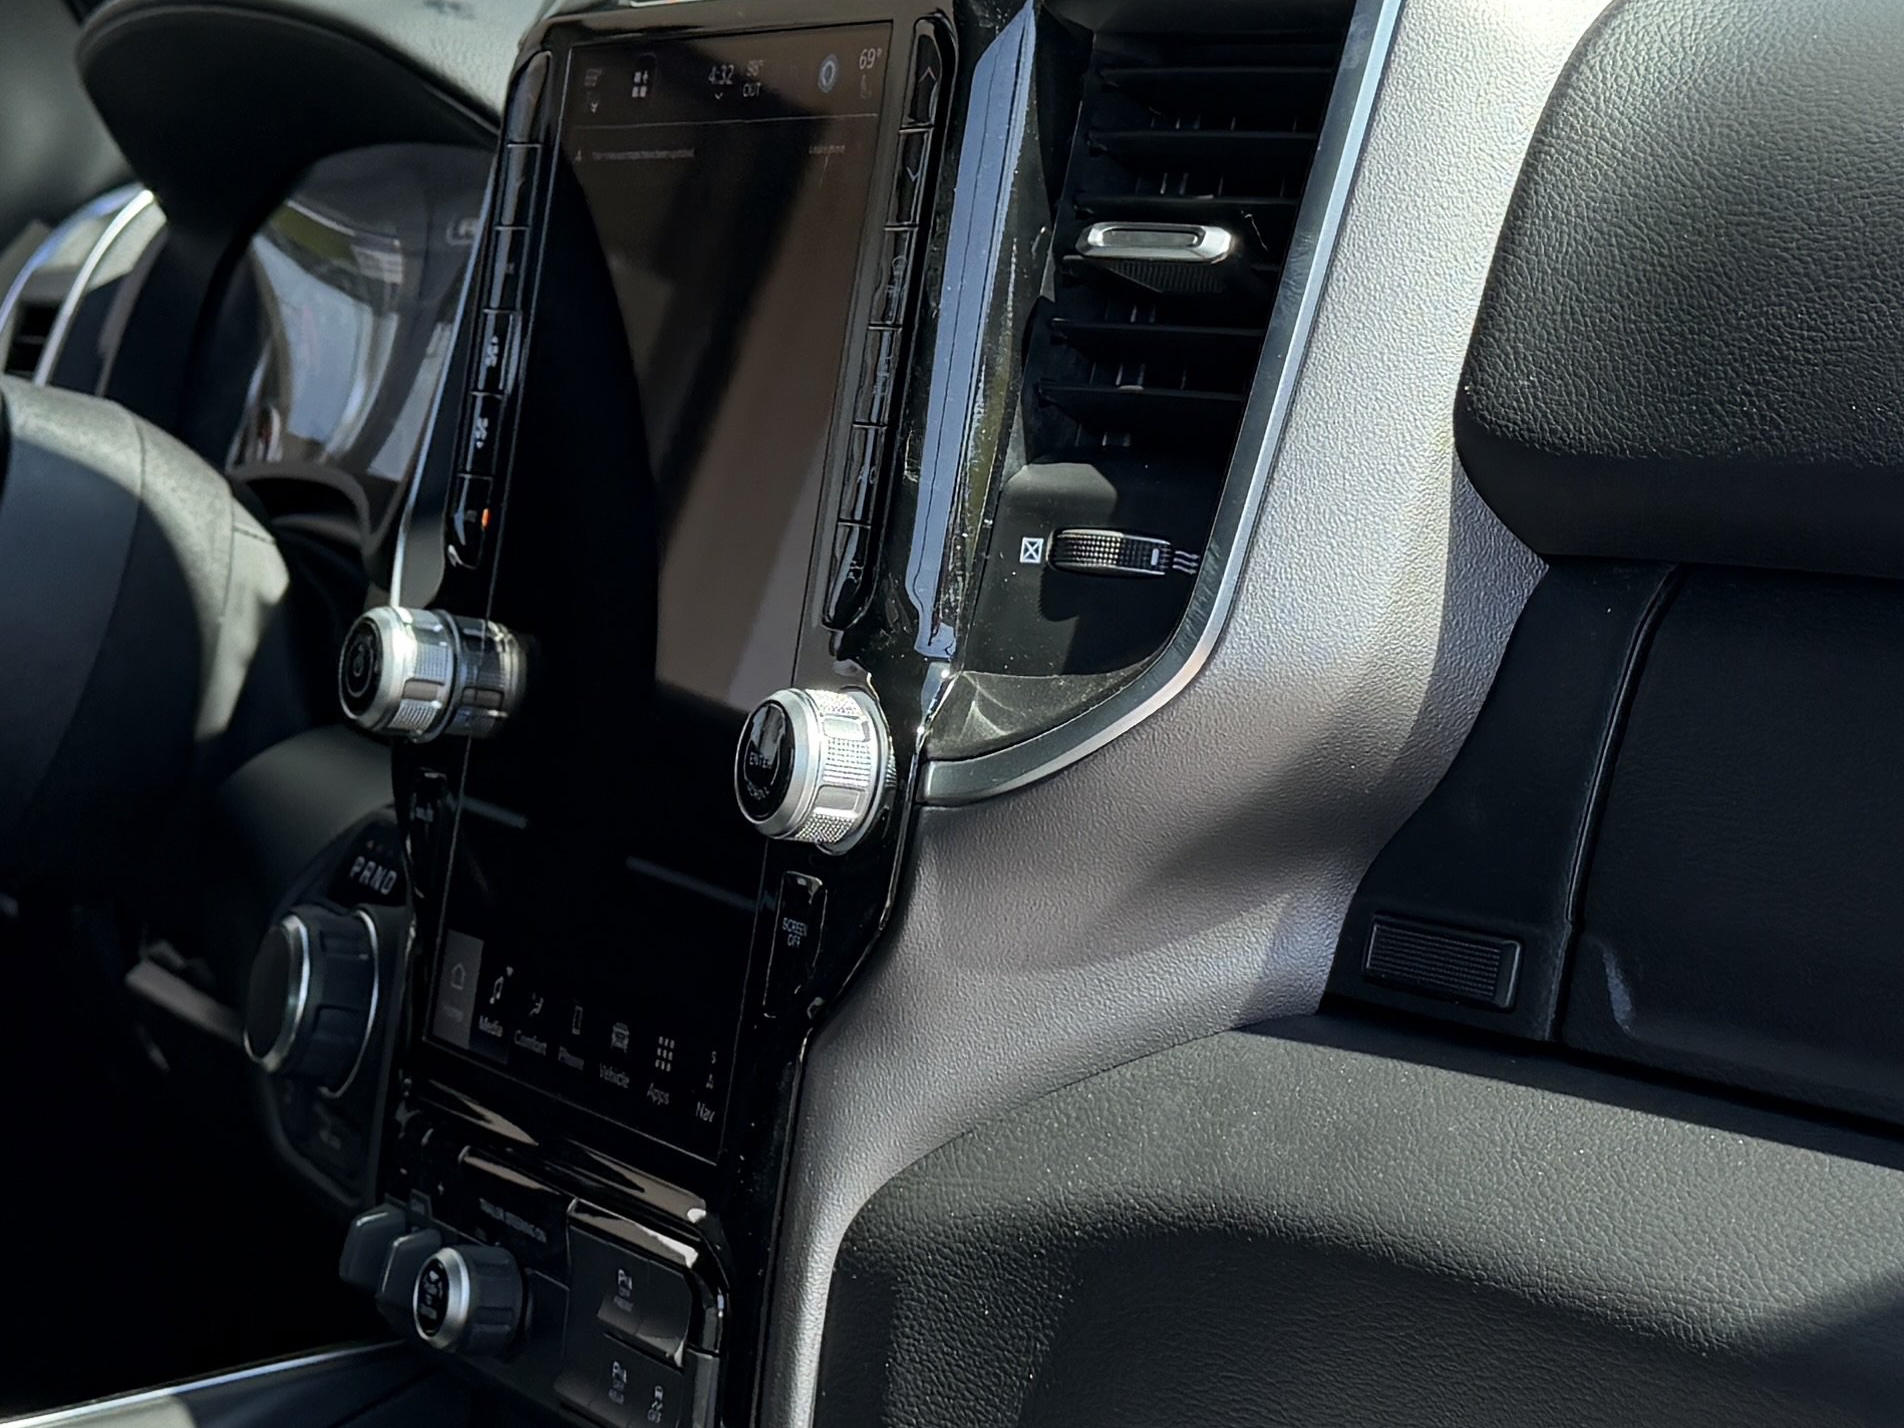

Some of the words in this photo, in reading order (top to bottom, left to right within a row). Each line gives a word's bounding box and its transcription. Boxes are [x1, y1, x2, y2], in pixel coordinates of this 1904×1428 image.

[858, 47, 882, 69] 69°
[707, 64, 735, 85] 4:32
[742, 81, 762, 98] OUT
[782, 916, 808, 938] SCREEN
[646, 1083, 671, 1108] Apps
[695, 1101, 716, 1124] Nav
